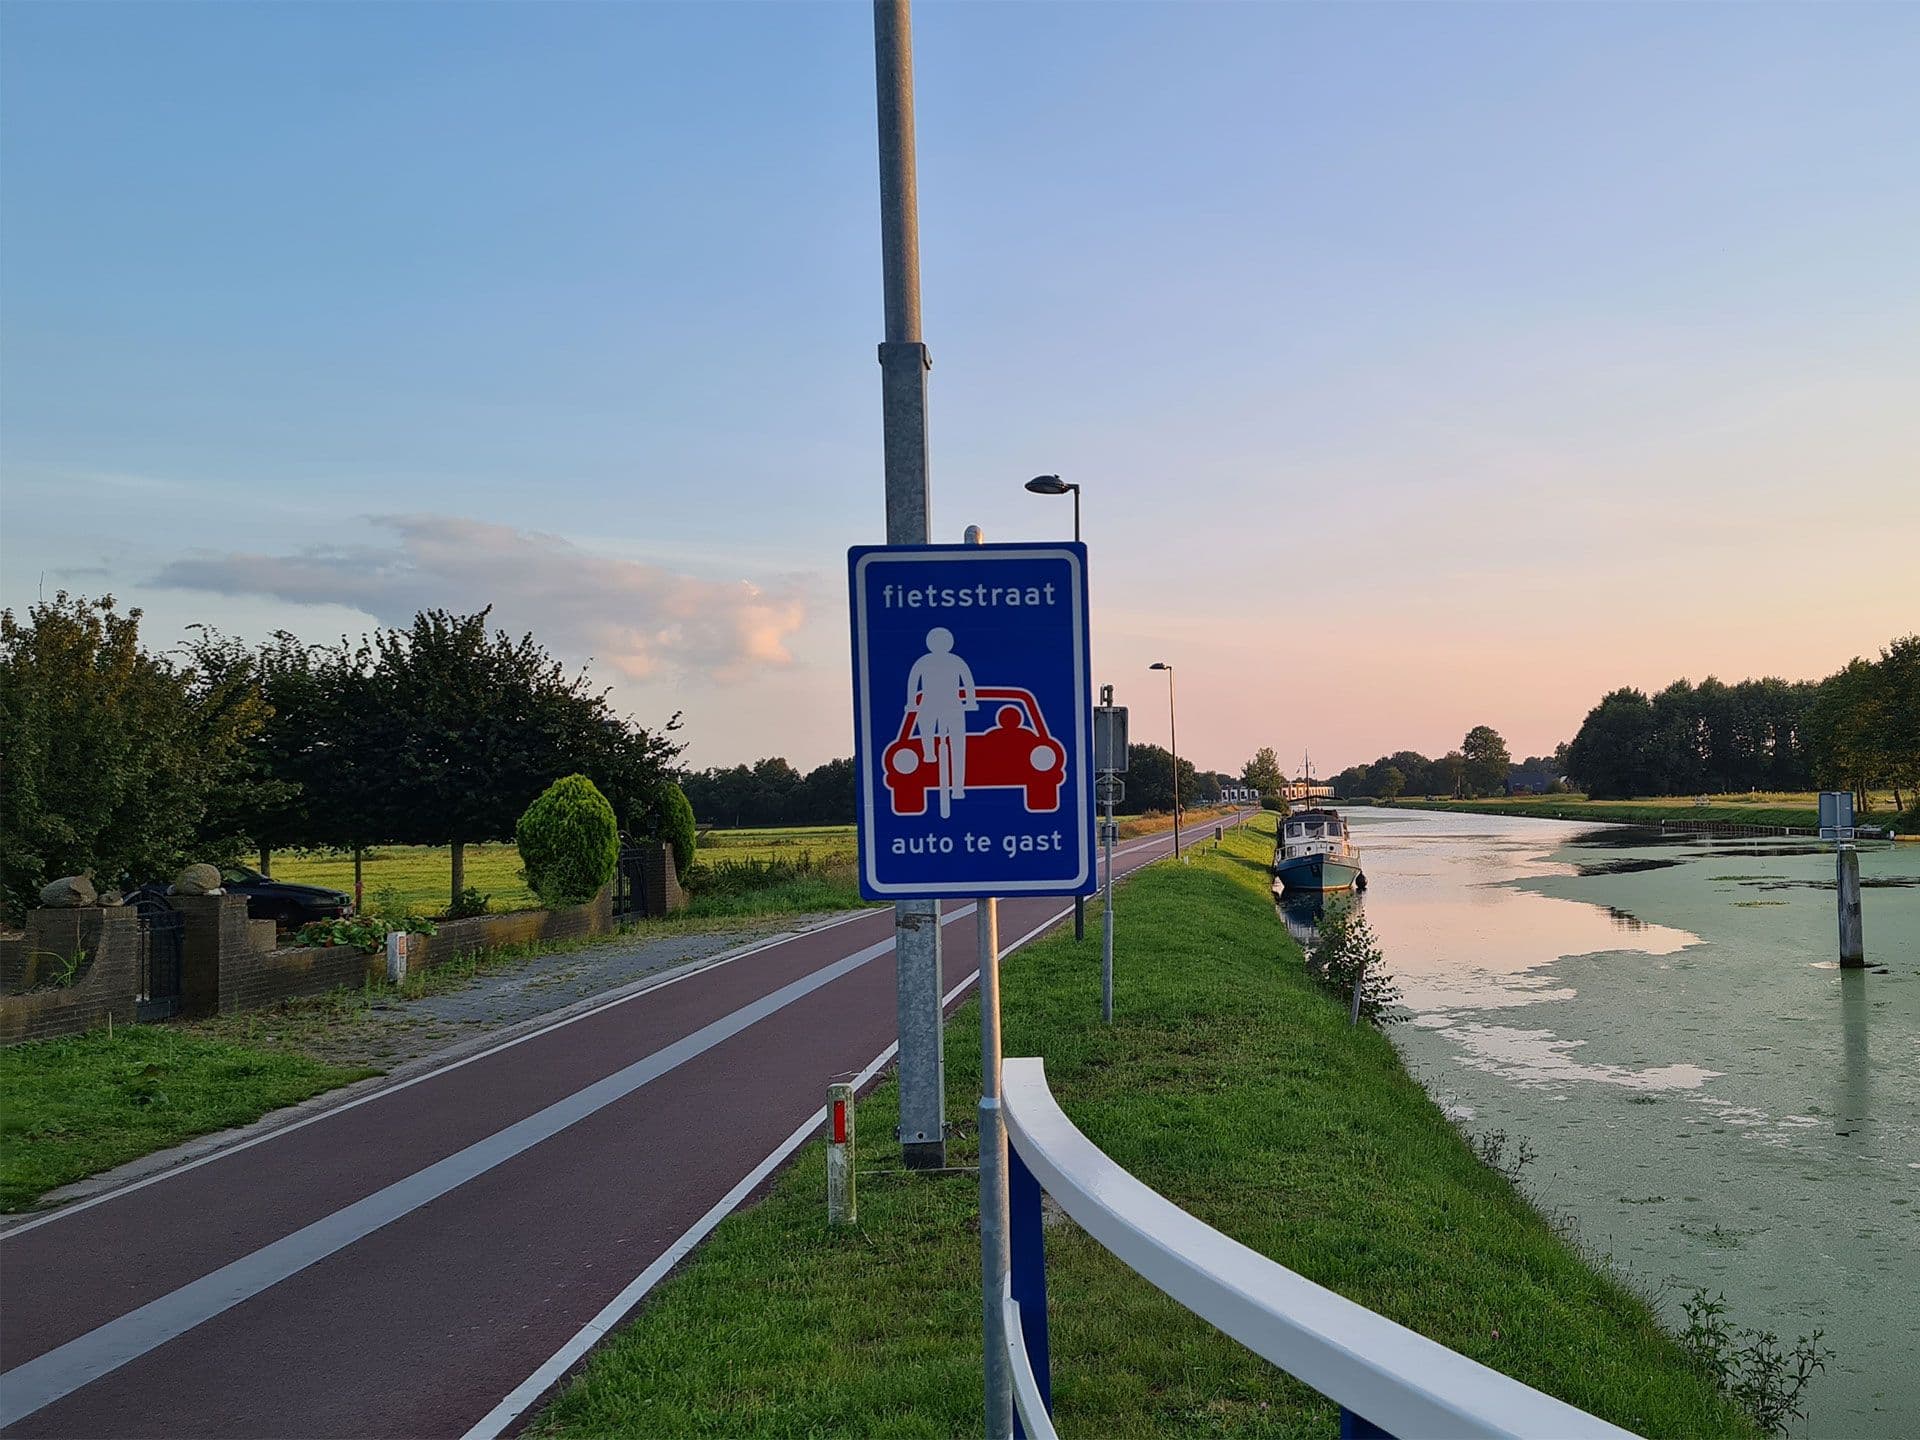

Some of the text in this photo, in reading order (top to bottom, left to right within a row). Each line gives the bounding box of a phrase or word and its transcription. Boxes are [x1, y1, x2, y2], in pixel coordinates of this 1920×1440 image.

[883, 583, 1055, 608] fietsstraat
[892, 830, 1062, 858] auto te gast
